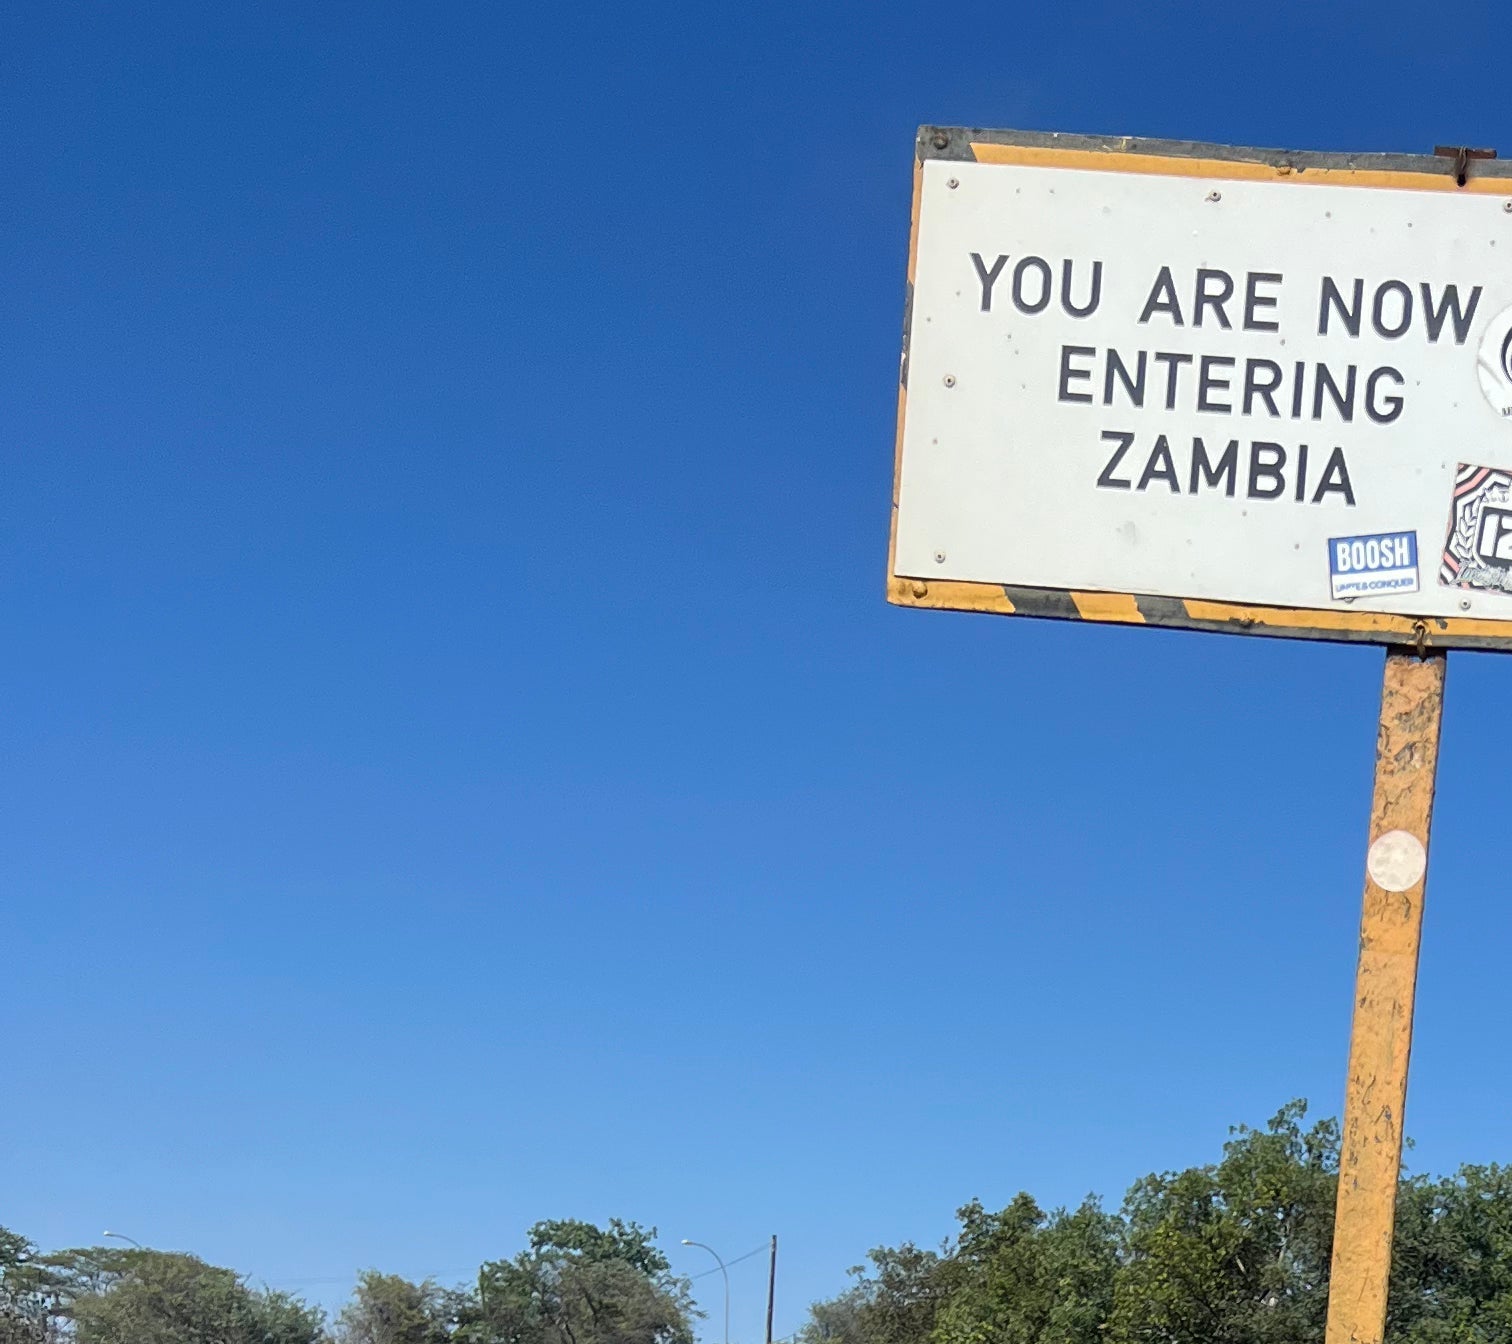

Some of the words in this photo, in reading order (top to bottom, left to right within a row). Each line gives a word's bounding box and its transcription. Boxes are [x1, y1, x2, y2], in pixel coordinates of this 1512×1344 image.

[968, 252, 1103, 320] YOU
[1137, 265, 1284, 332] ARE
[1316, 275, 1484, 345] NOW
[1057, 344, 1406, 425] ENTERING
[1096, 430, 1357, 507] ZAMBIA
[1336, 537, 1410, 572] BOOSH
